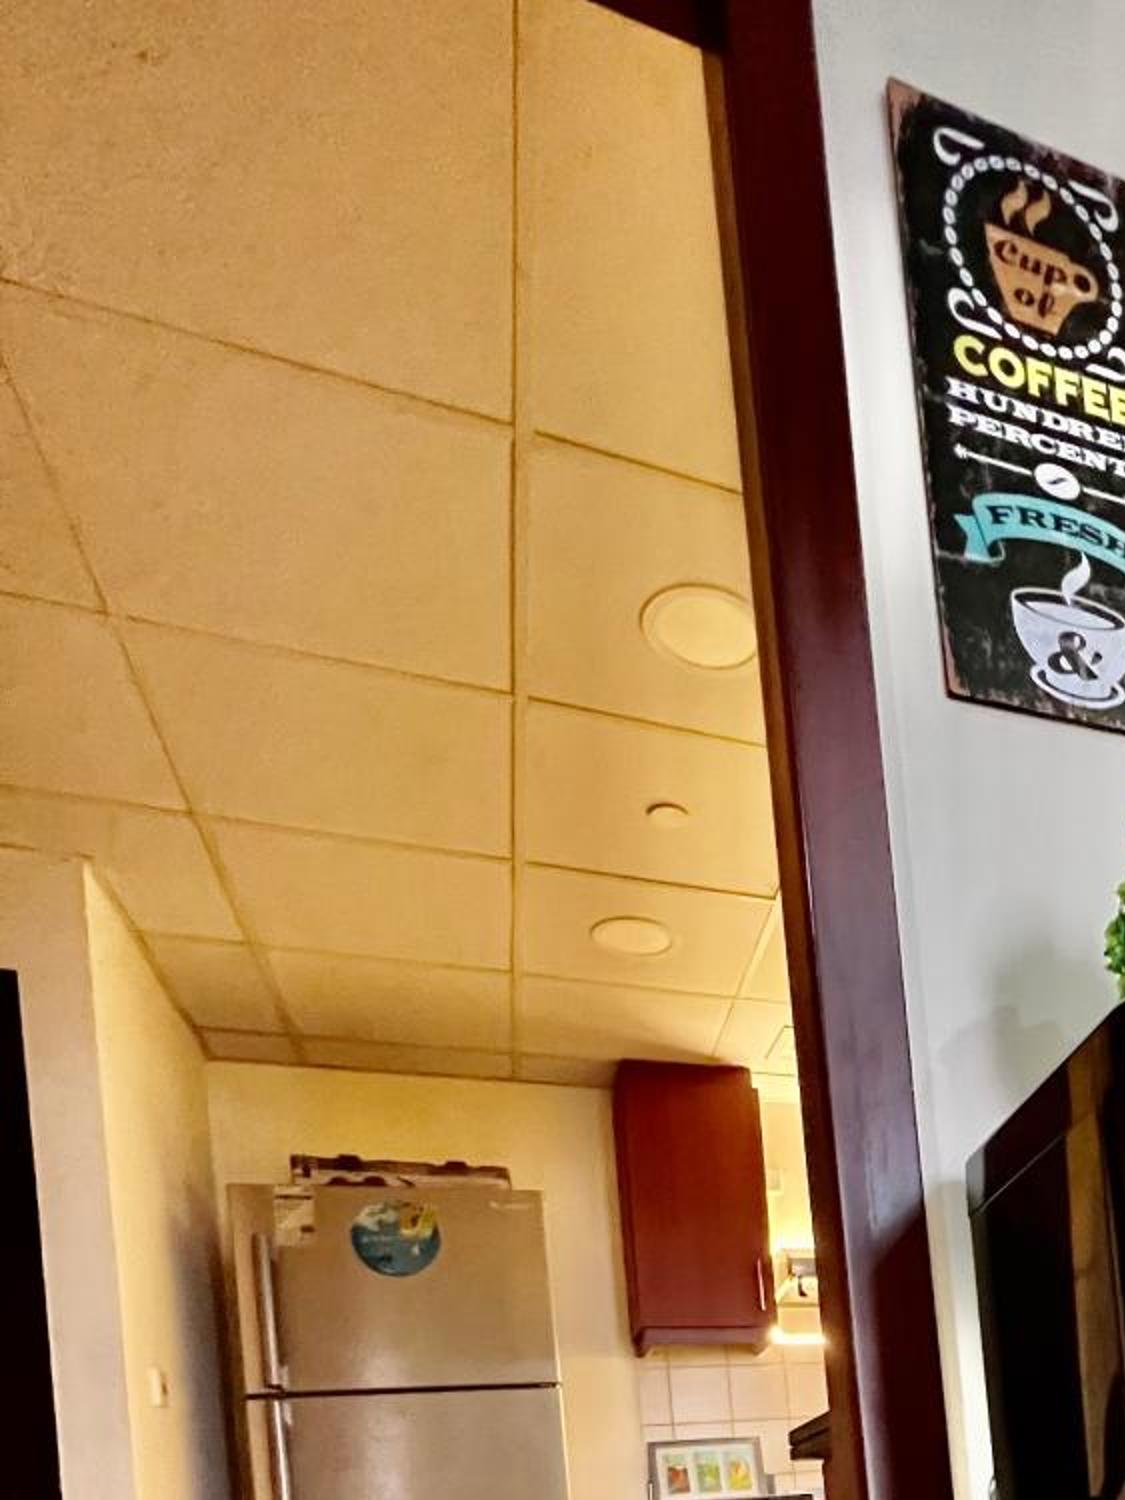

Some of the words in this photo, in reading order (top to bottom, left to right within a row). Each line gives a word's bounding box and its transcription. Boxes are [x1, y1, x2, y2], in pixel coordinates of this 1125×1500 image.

[993, 240, 1067, 287] Cup
[1014, 288, 1056, 319] of
[1047, 631, 1103, 681] &
